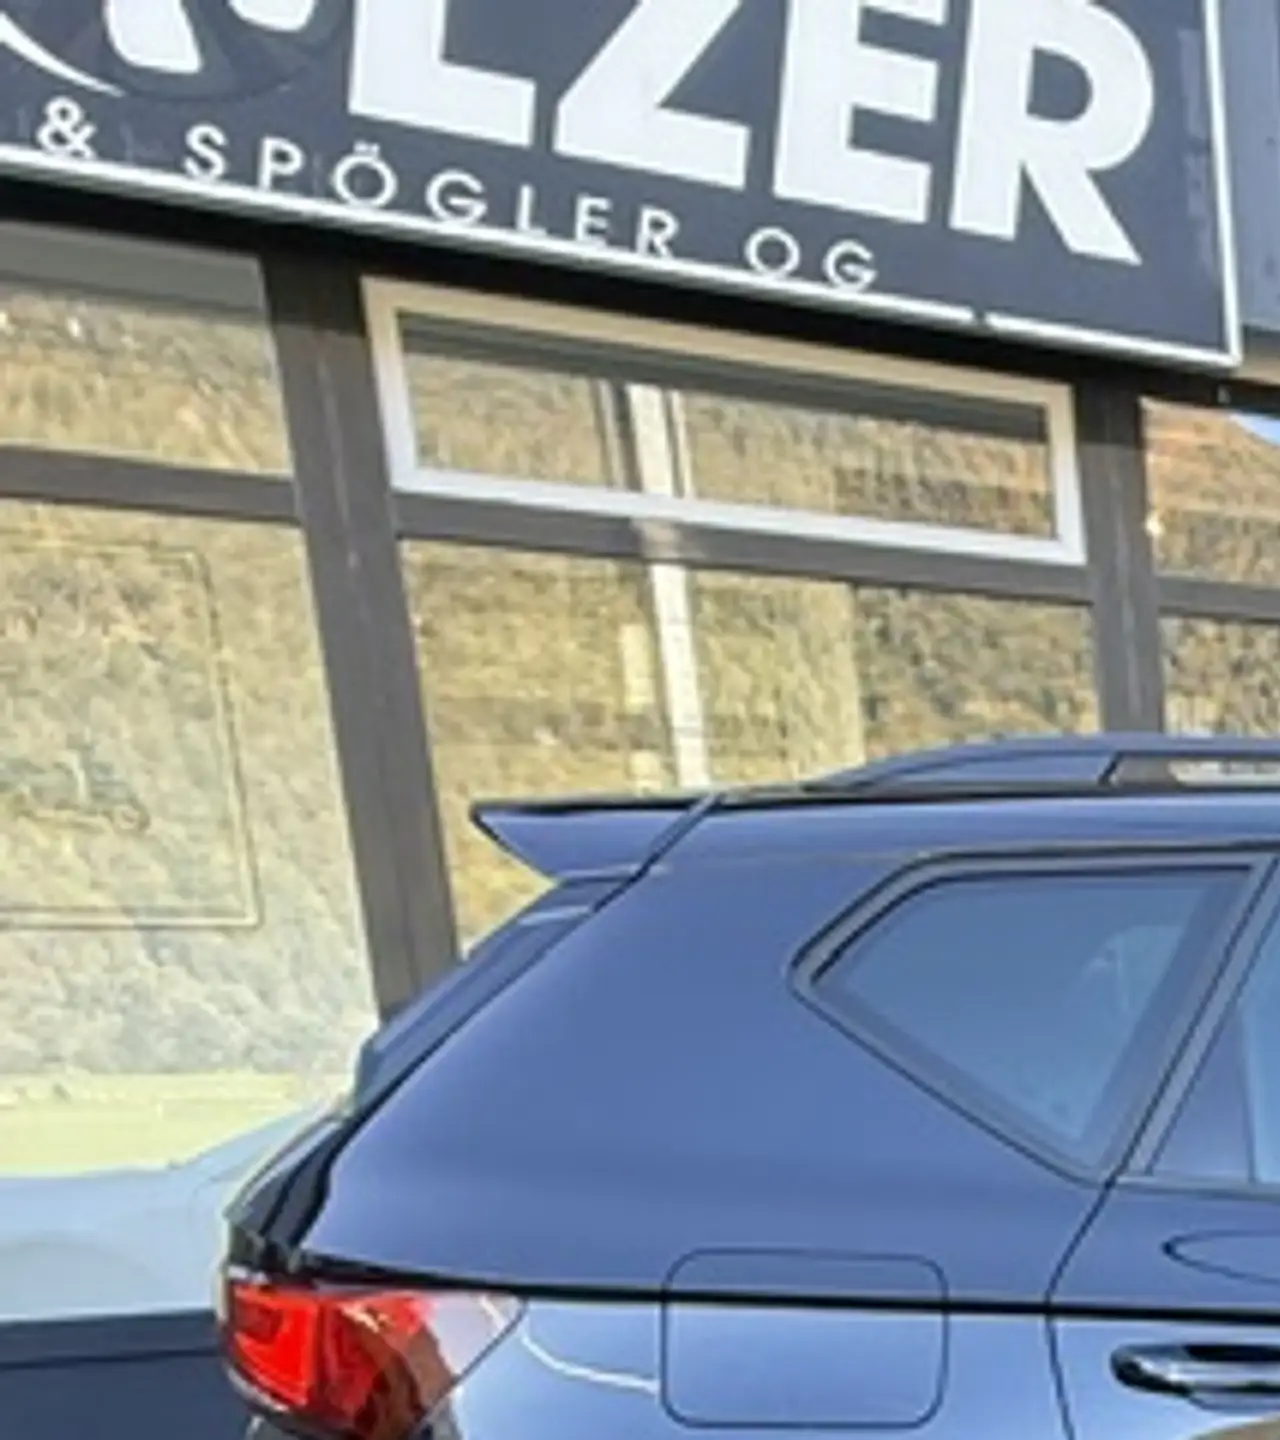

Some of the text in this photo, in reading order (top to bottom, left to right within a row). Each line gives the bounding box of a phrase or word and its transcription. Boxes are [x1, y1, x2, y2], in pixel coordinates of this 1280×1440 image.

[36, 96, 878, 292] & SPÖGLER OG
